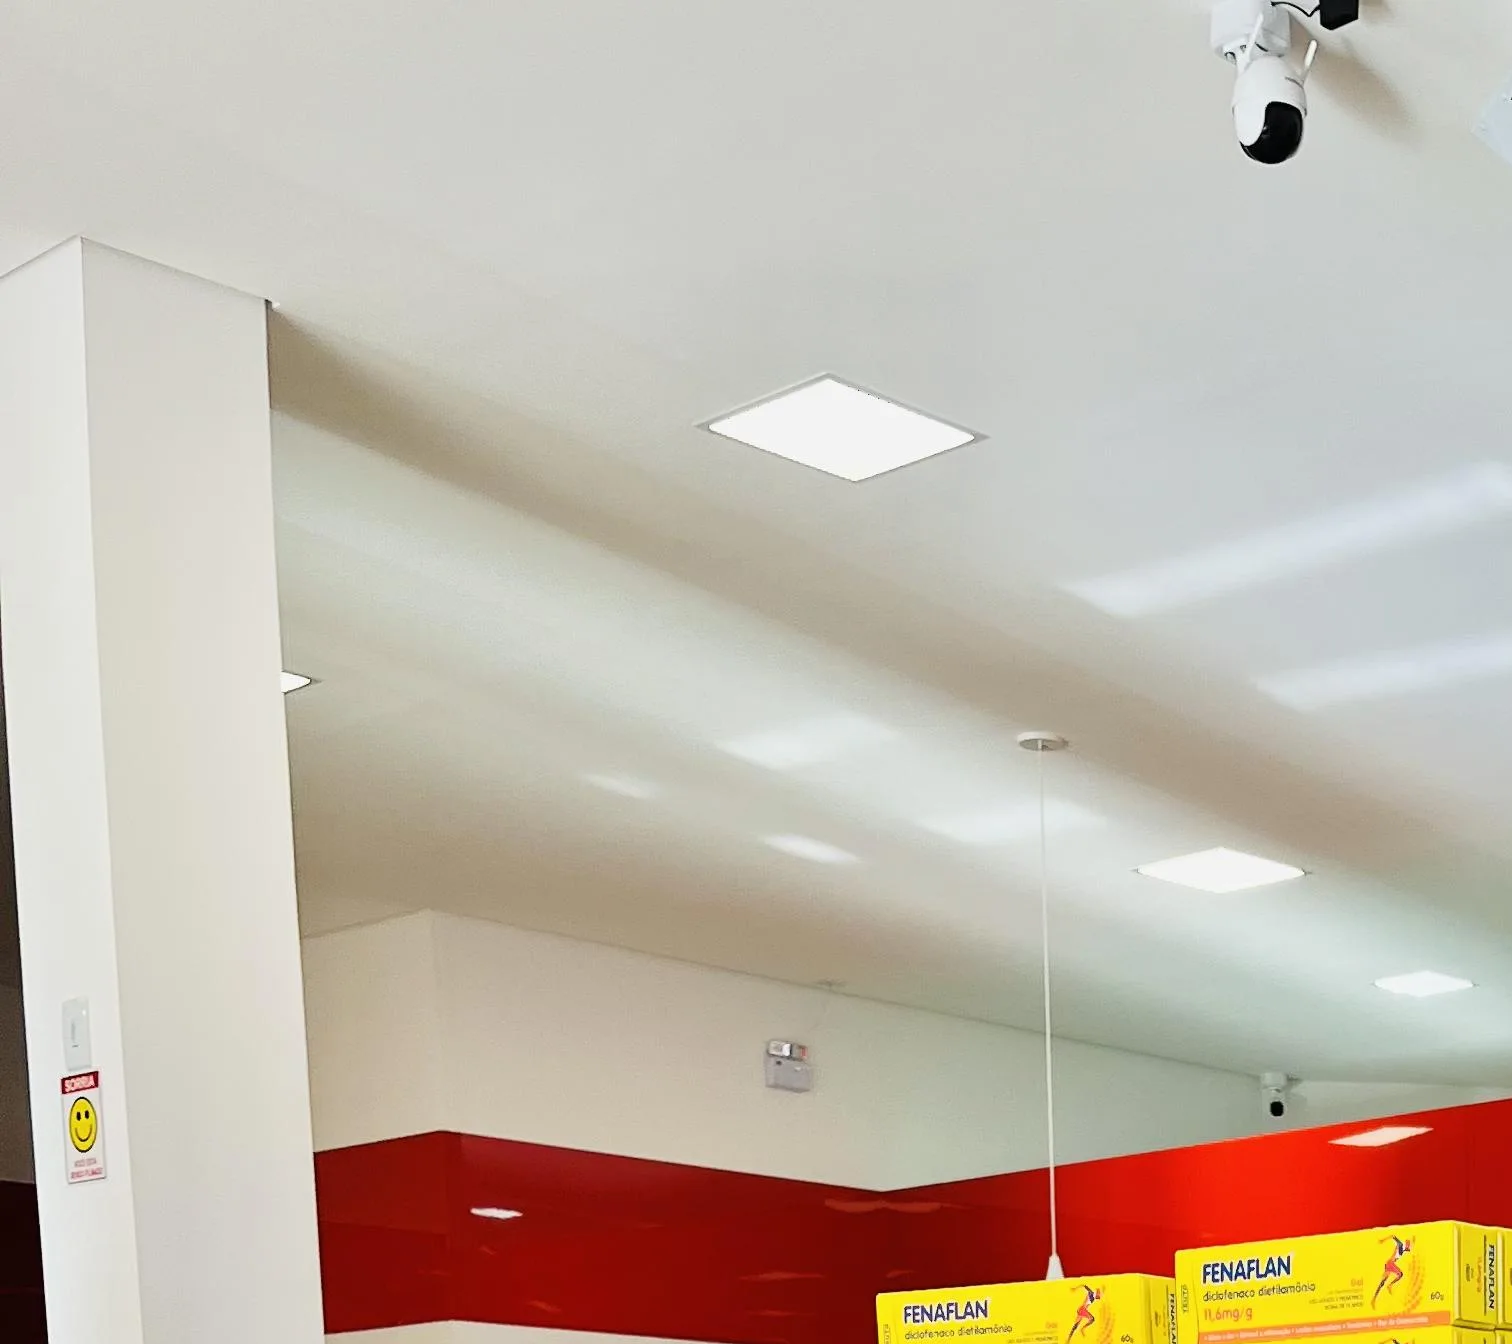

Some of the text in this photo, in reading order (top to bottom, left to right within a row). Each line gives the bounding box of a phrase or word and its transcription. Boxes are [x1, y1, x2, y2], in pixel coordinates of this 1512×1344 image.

[1202, 1256, 1292, 1283] FENAFLAN
[904, 1300, 989, 1324] FENAFLAN
[1203, 1306, 1253, 1321] 11,6mg/g
